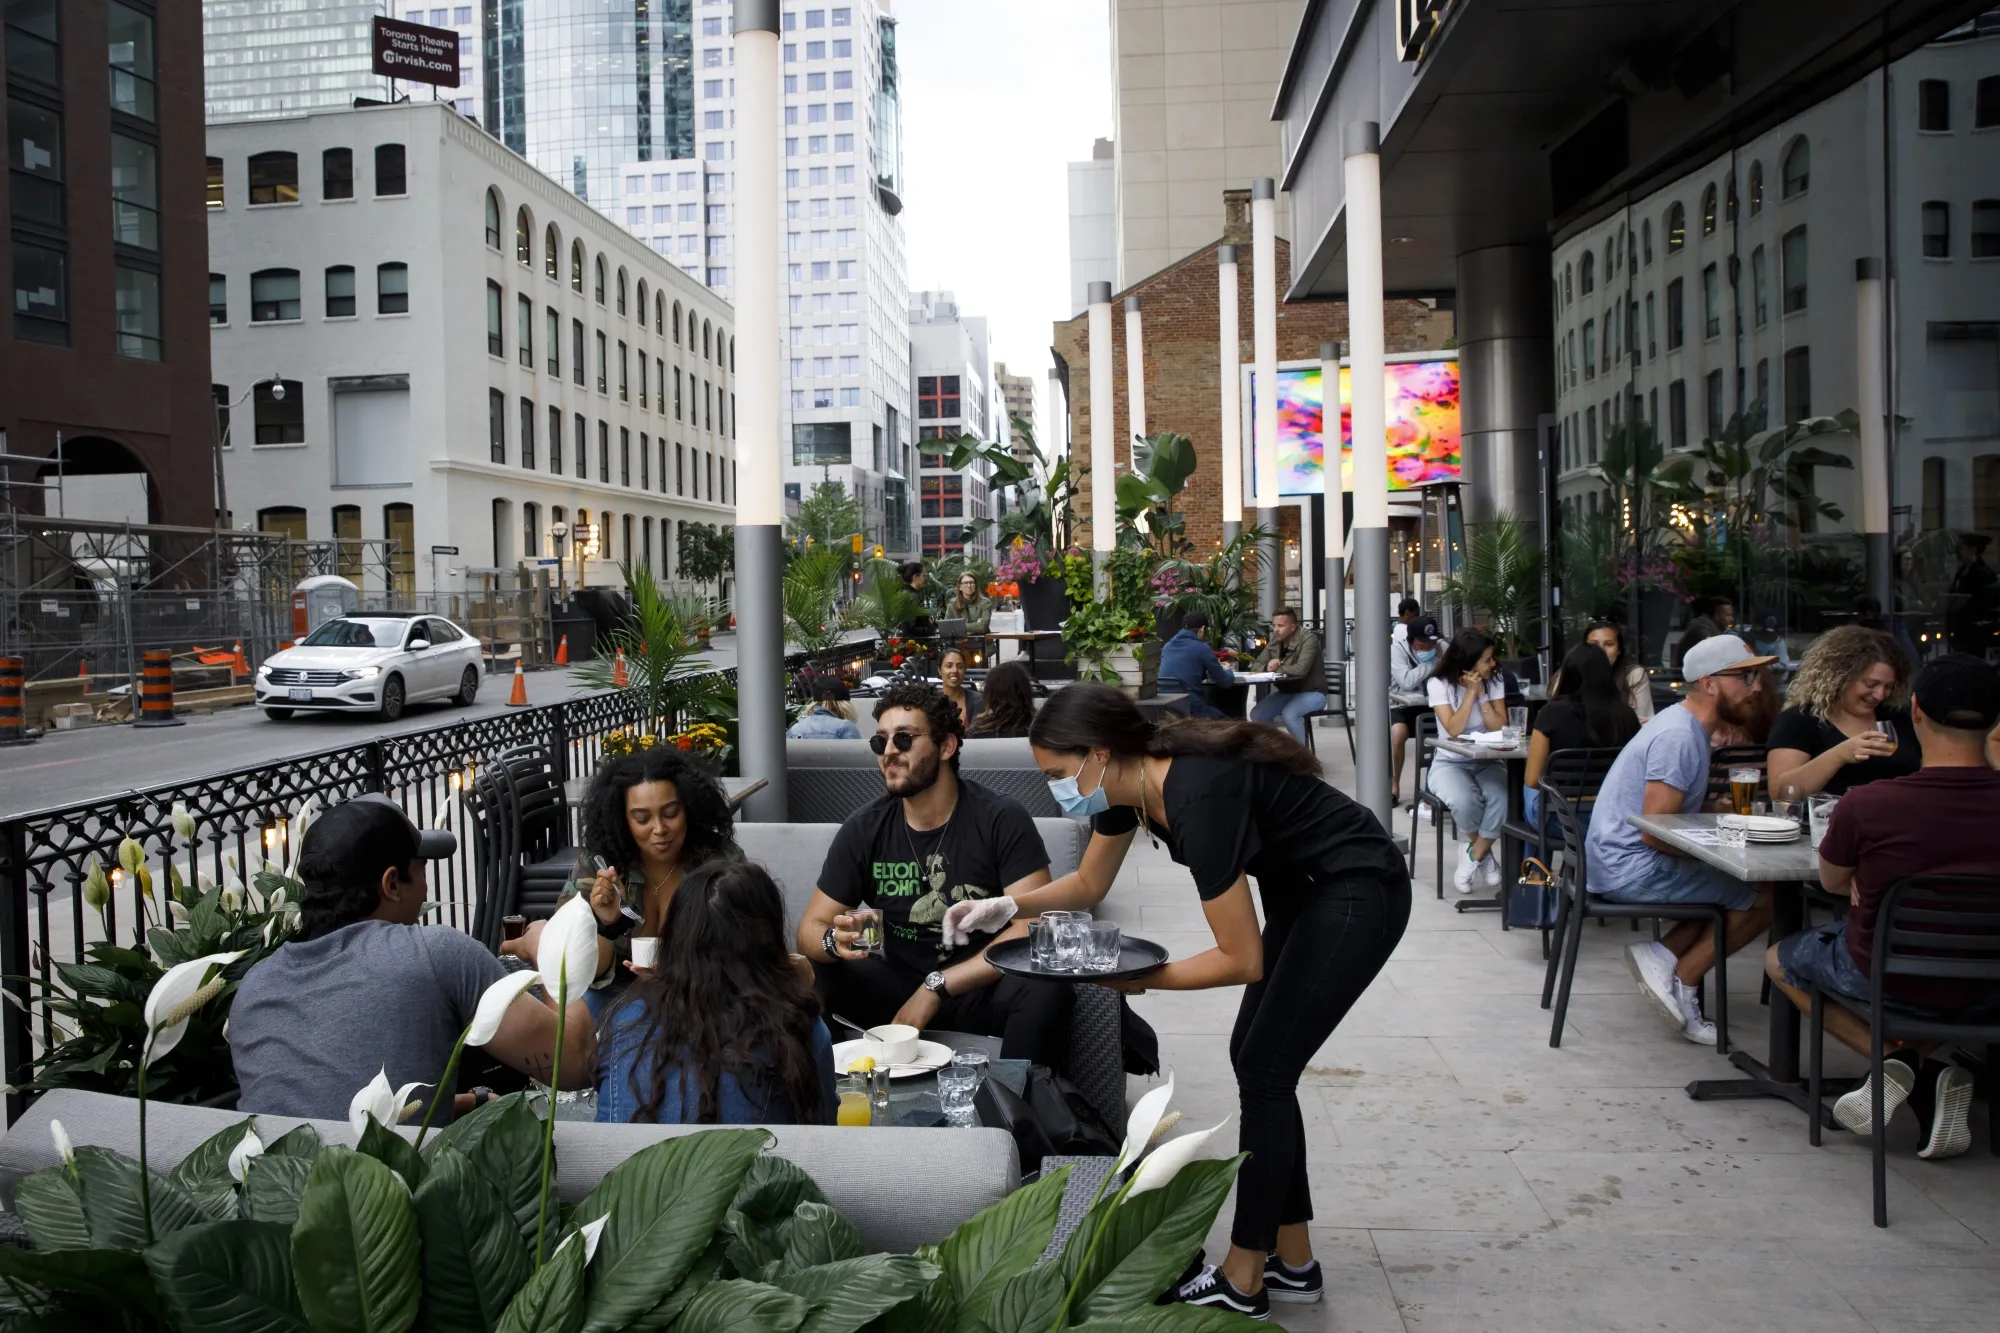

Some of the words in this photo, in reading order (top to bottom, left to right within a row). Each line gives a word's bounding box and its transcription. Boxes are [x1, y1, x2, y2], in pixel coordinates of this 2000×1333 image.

[380, 27, 417, 42] Toronto
[419, 34, 454, 49] Theatre
[391, 38, 419, 51] Starts
[421, 44, 443, 56] Here
[873, 861, 920, 879] ELTON
[876, 879, 921, 896] JOHN
